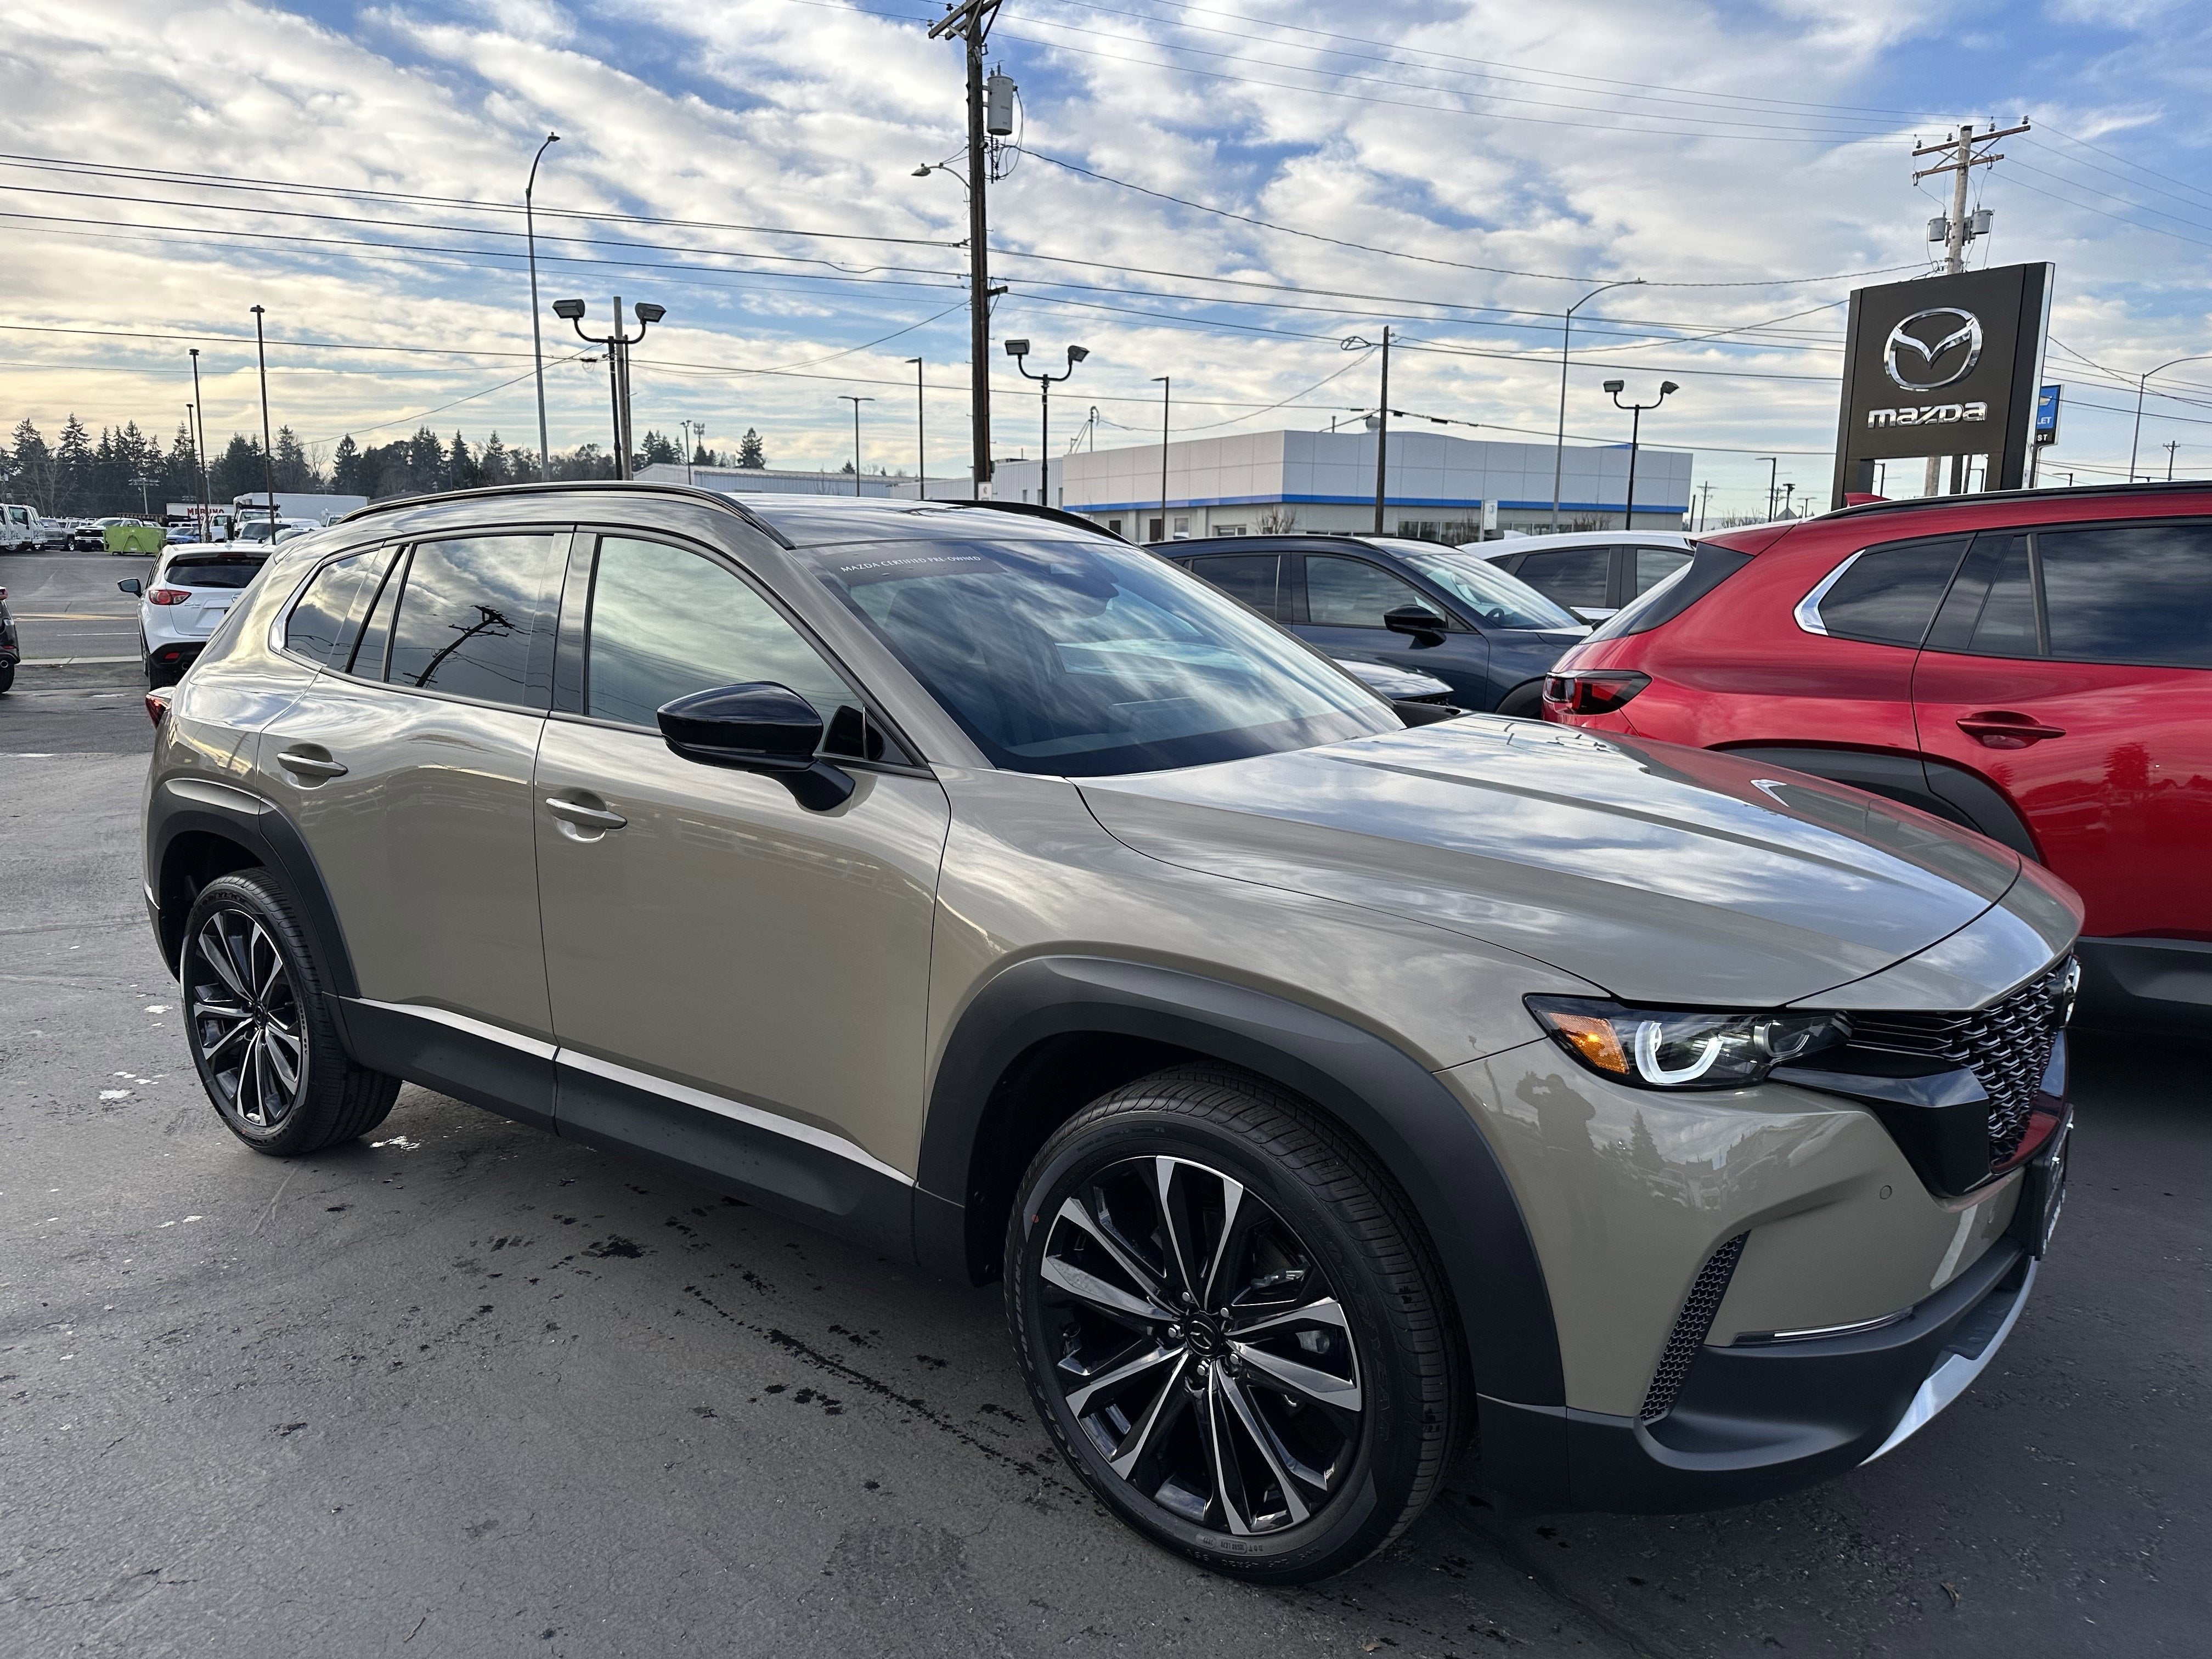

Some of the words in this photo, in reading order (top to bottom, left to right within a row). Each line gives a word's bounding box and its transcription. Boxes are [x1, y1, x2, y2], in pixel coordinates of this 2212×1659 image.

[187, 508, 224, 516] MERINO
[840, 562, 880, 572] MAZDA
[881, 557, 927, 567] CERTIFIED
[1015, 1246, 1035, 1372] TOURING
